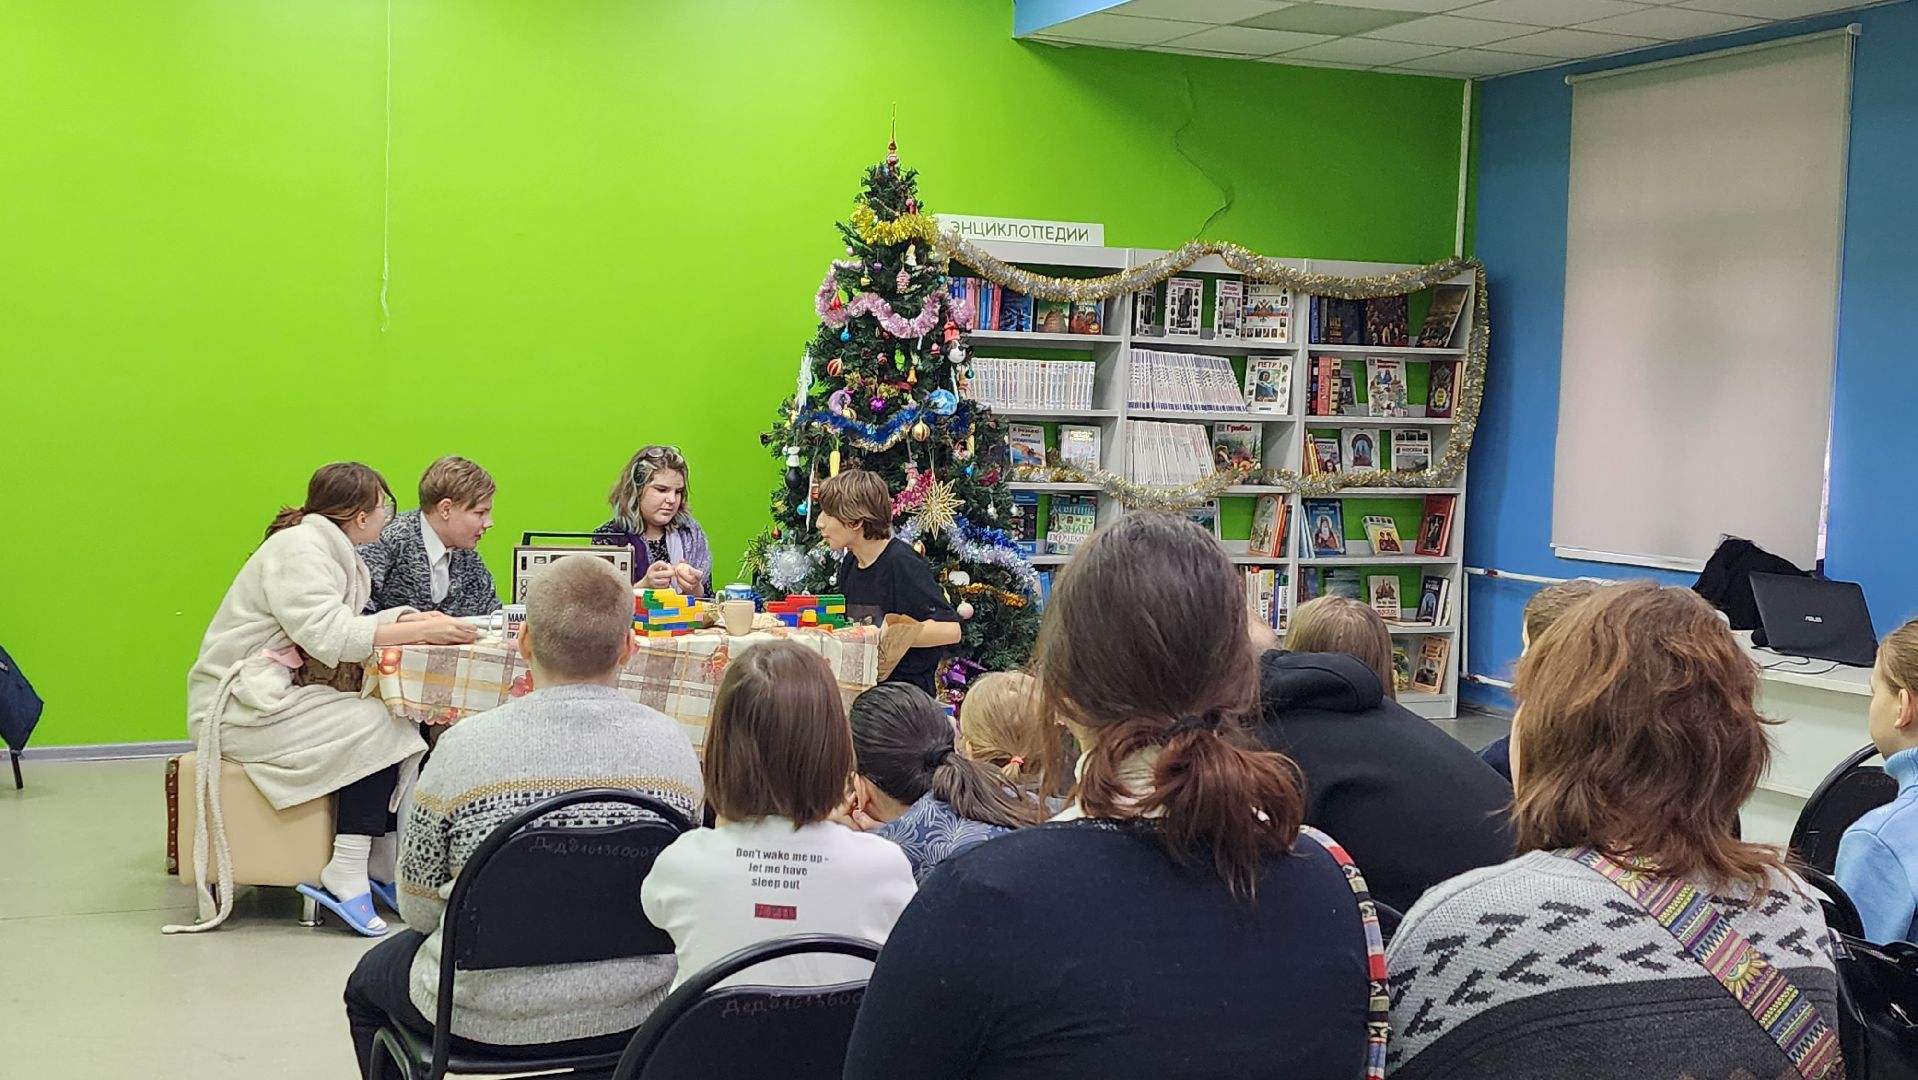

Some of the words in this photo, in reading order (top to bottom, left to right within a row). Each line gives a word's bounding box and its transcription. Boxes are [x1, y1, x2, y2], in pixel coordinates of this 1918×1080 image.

[950, 221, 1089, 243] ЭНЦИКЛОПЕДИИ
[1226, 424, 1252, 432] Грибы
[507, 613, 527, 622] МАМ
[736, 847, 761, 859] Don't
[763, 850, 790, 861] wake
[792, 852, 808, 862] me
[810, 854, 823, 863] up
[748, 862, 762, 873] let
[764, 865, 780, 874] me
[783, 864, 808, 876] have
[751, 877, 780, 889] sleep
[783, 879, 800, 890] out
